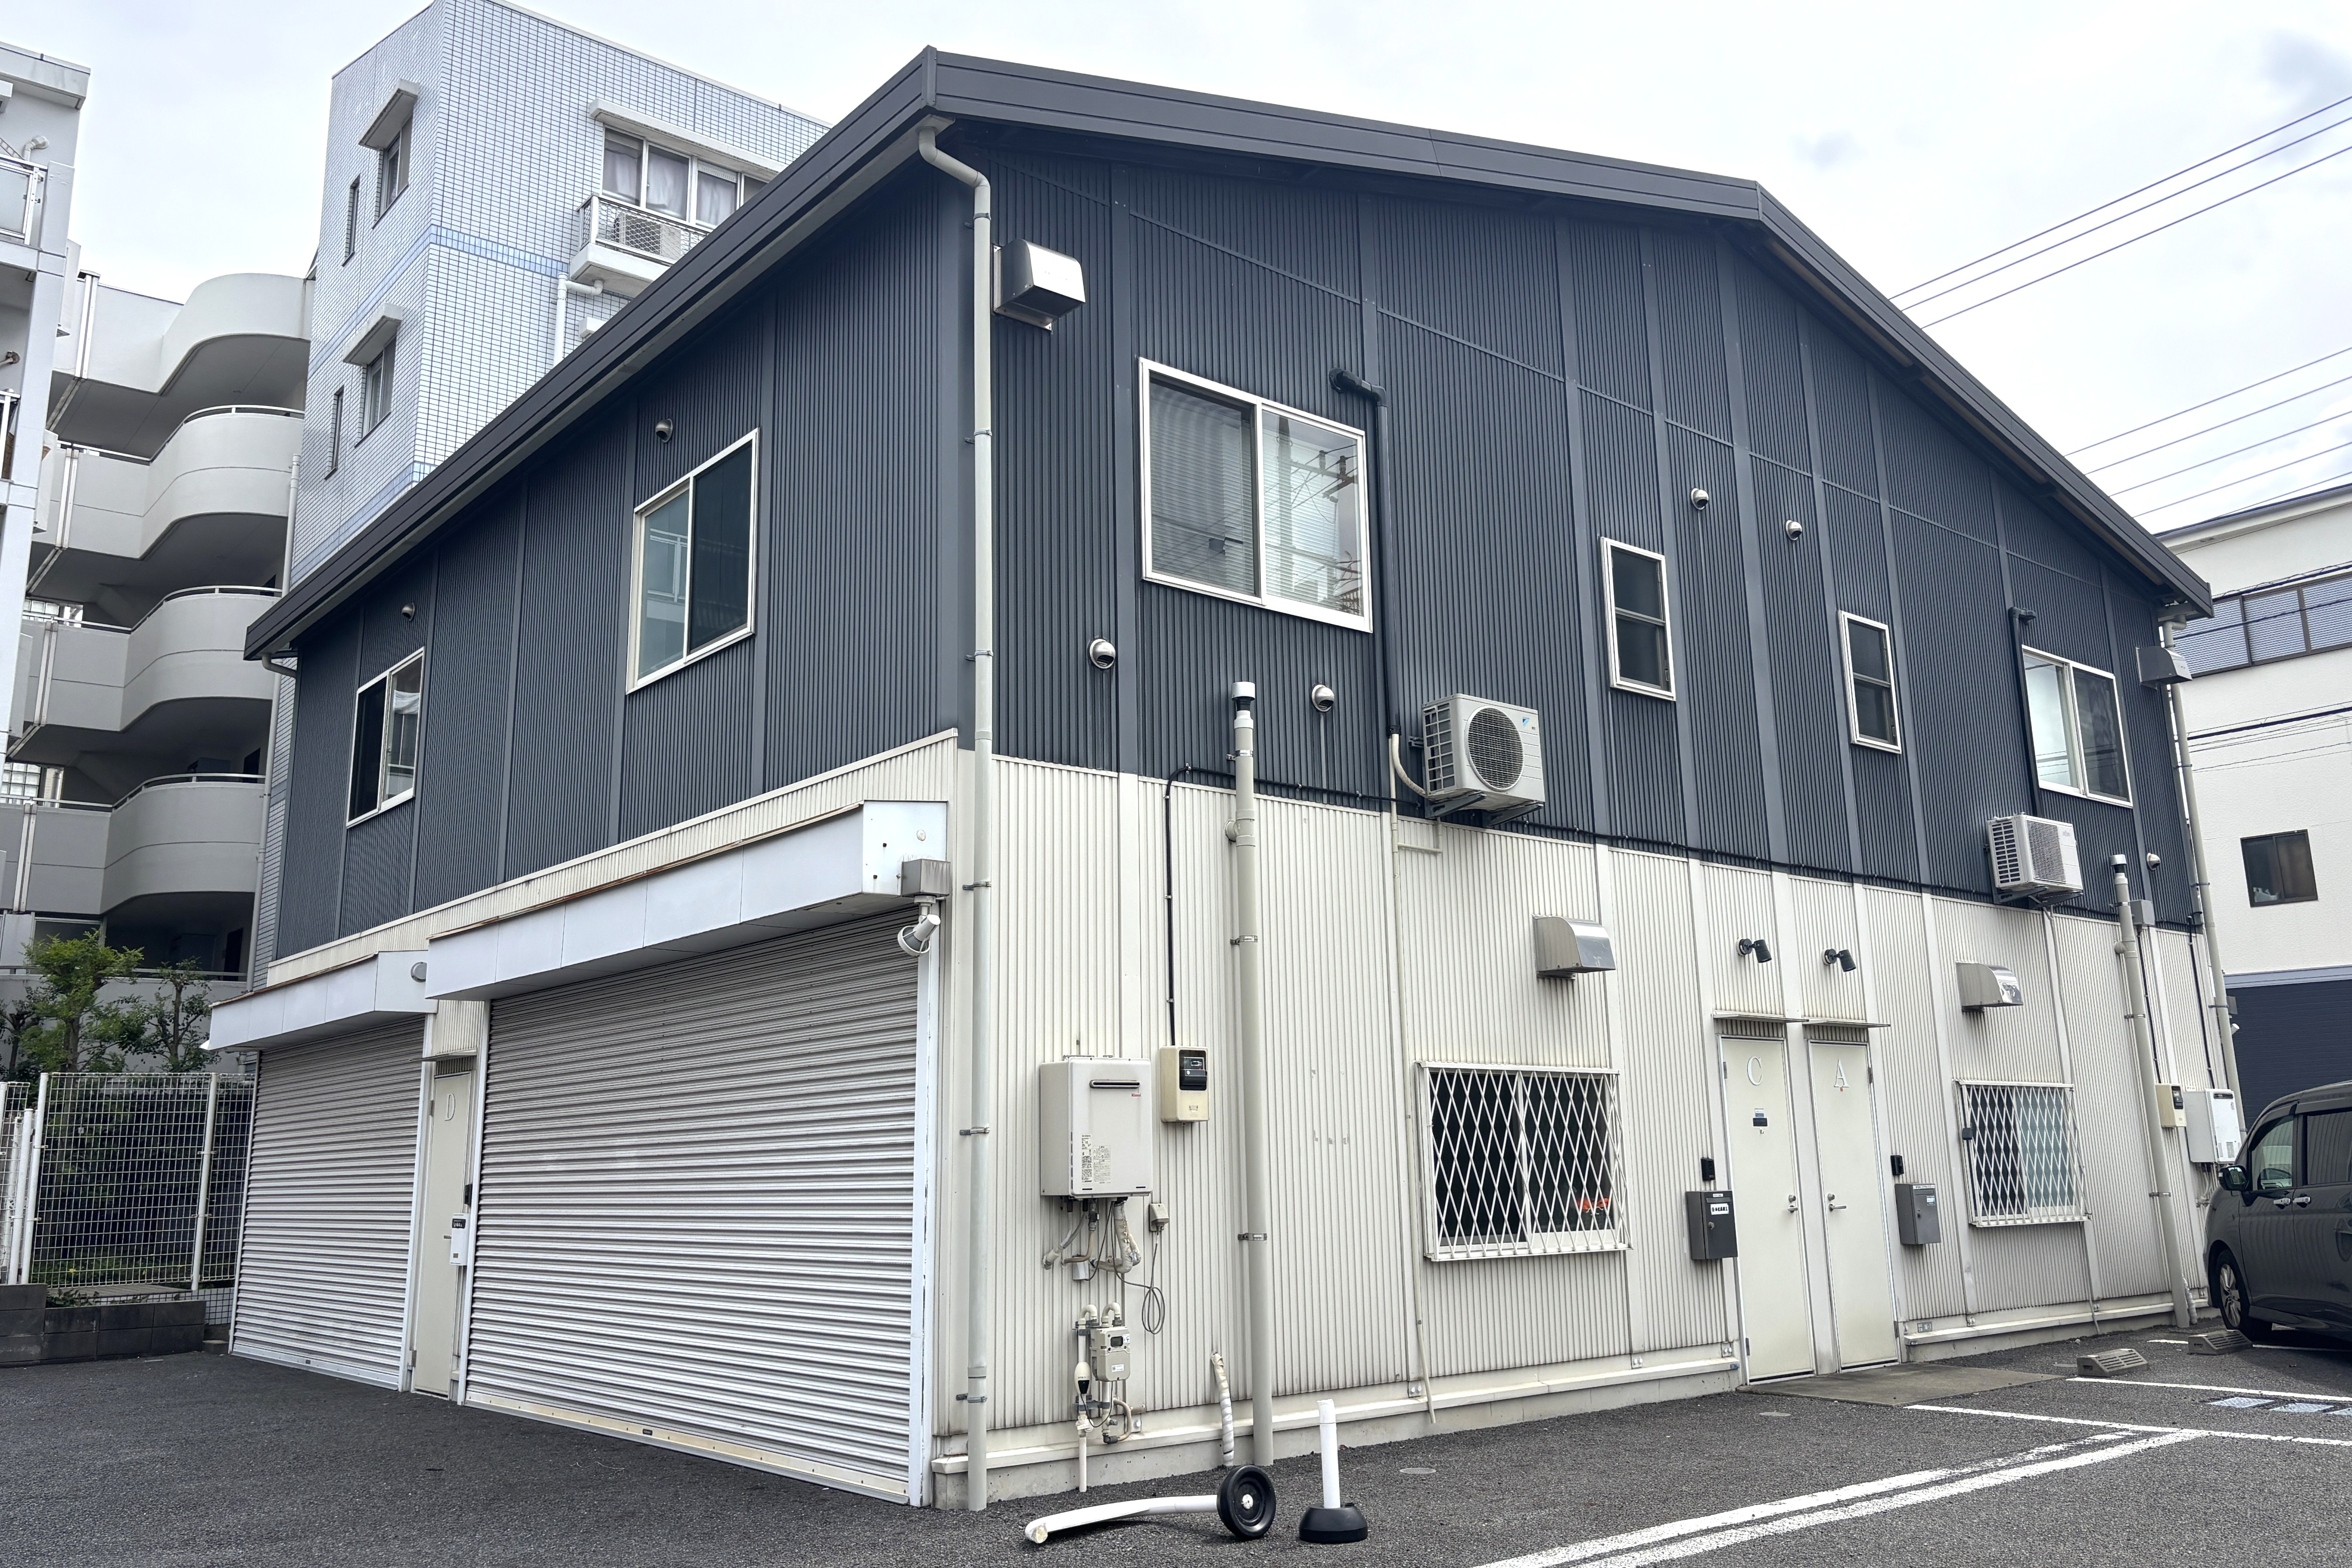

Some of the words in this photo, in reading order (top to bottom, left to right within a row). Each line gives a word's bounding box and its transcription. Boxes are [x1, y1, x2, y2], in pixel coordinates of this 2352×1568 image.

[1747, 1056, 1763, 1086] C
[1834, 1059, 1850, 1088] A
[444, 1093, 456, 1121] D
